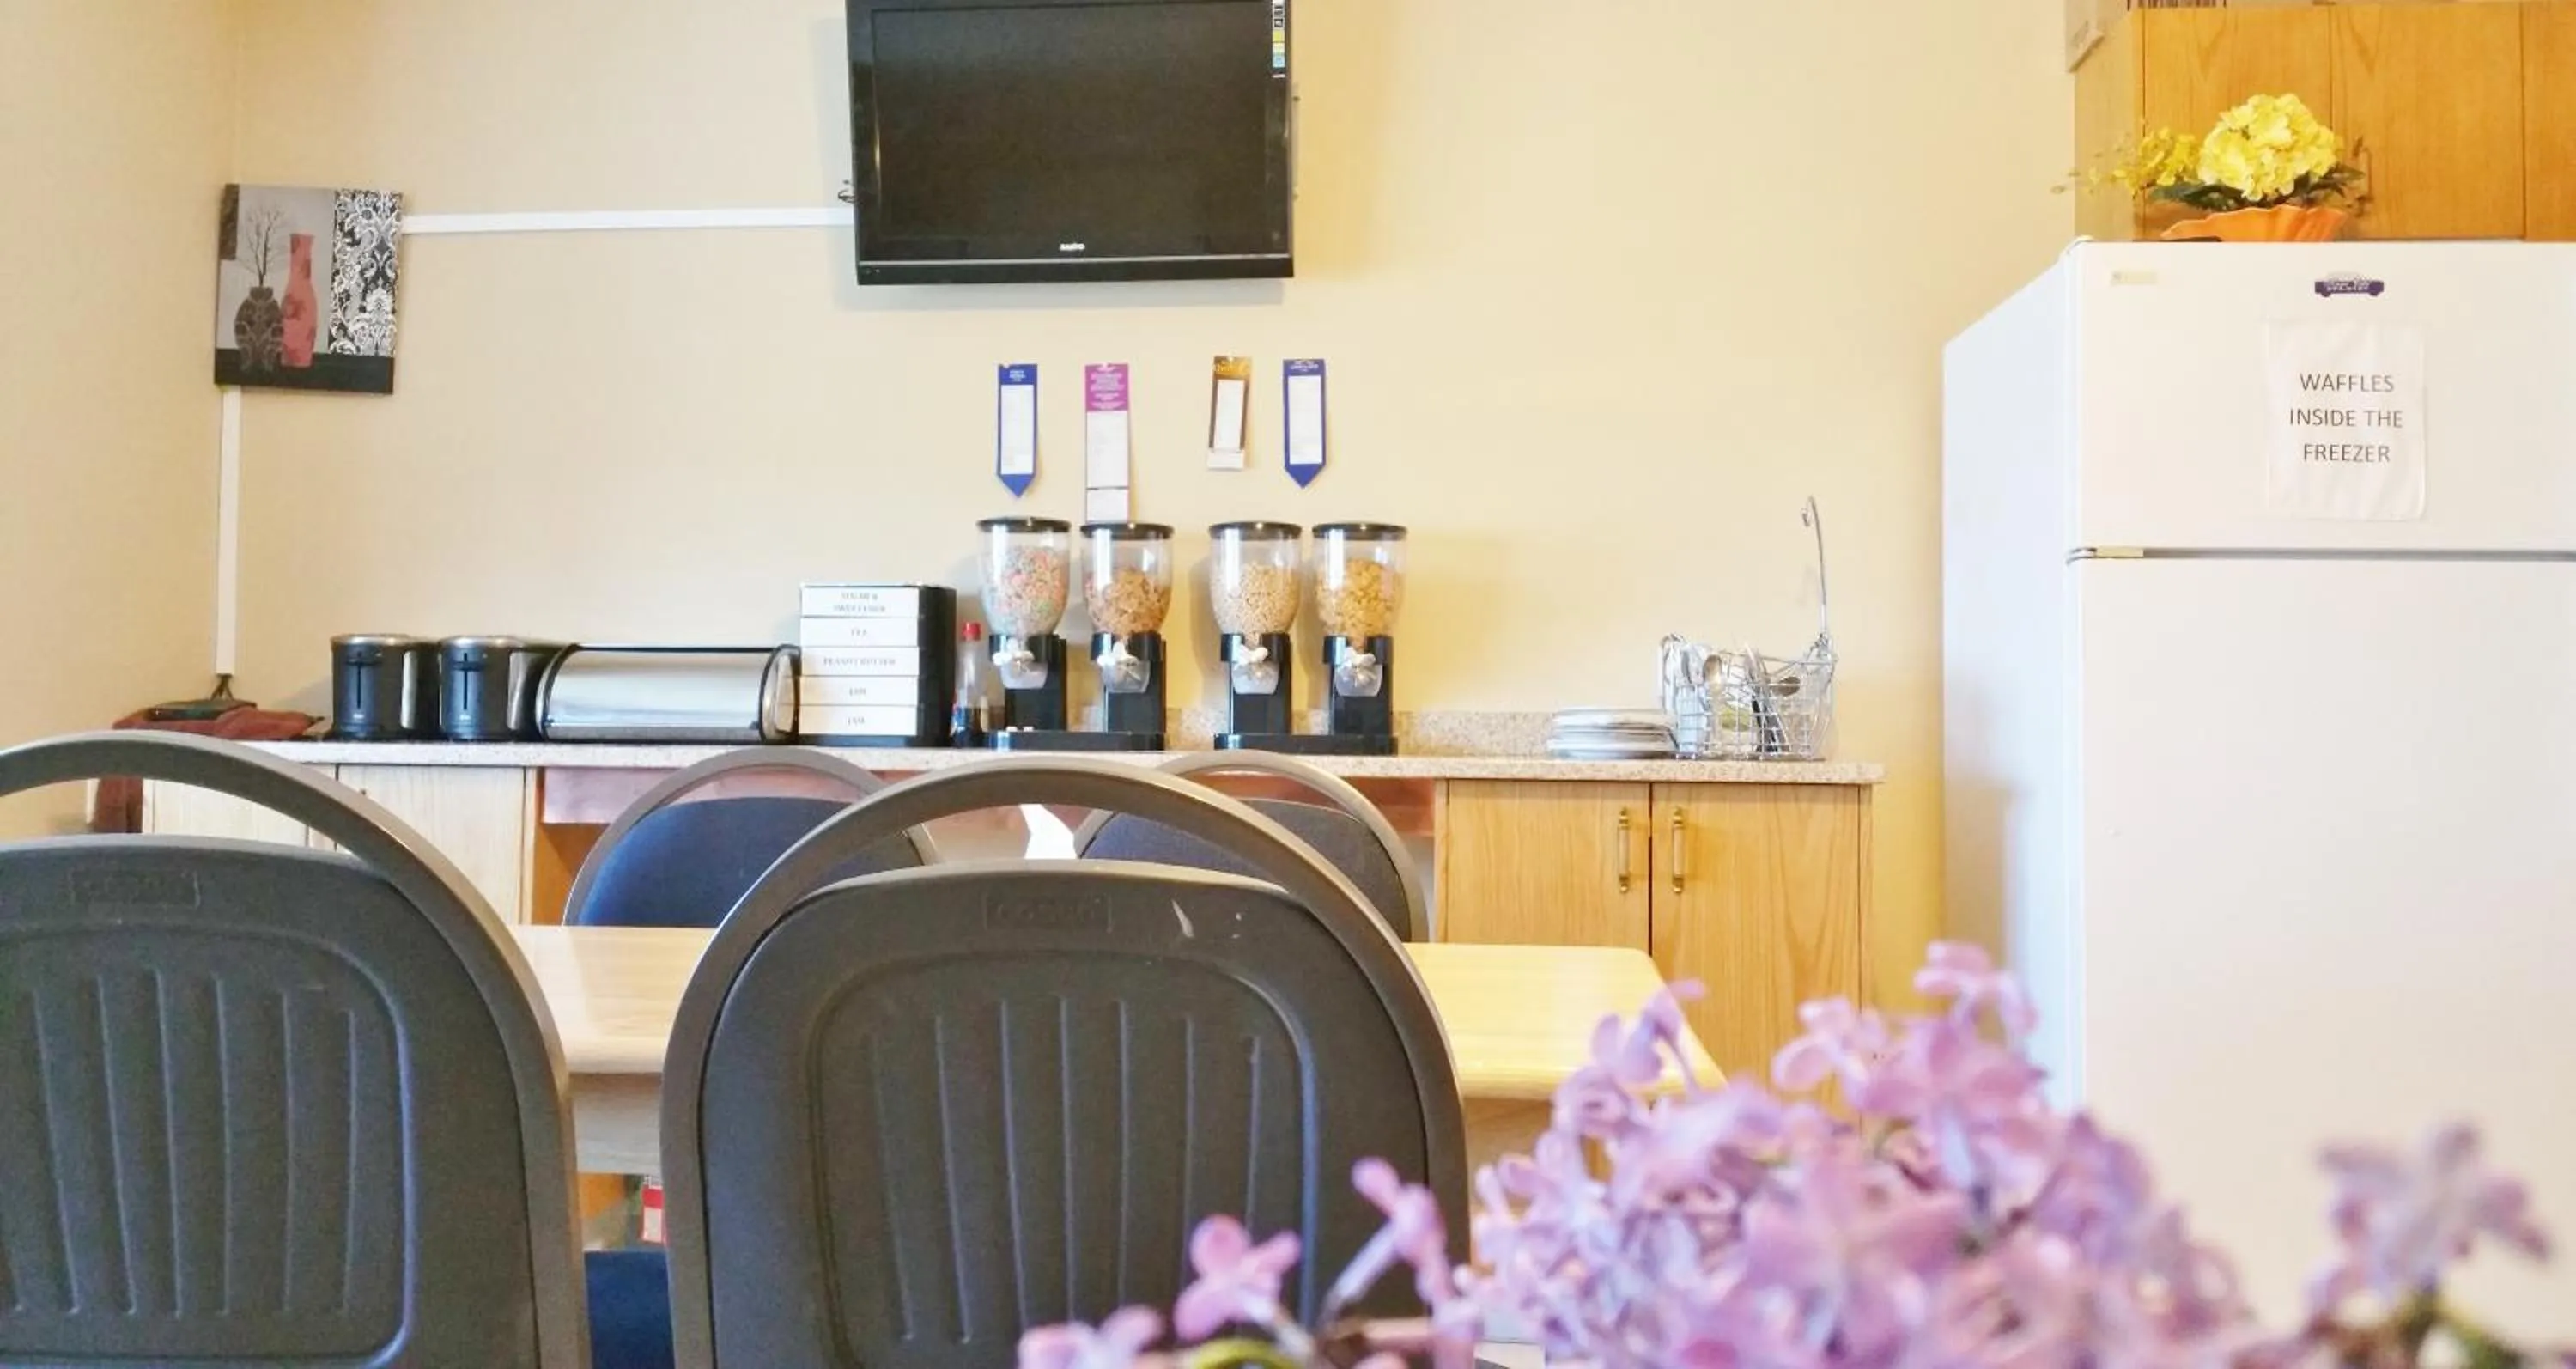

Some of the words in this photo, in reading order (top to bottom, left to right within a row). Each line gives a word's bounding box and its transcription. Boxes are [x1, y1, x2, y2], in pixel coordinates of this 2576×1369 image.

[2299, 372, 2395, 393] WAFFLES
[2289, 407, 2357, 428] INSIDE
[2362, 409, 2403, 429] THE
[2303, 442, 2391, 464] FREEZER
